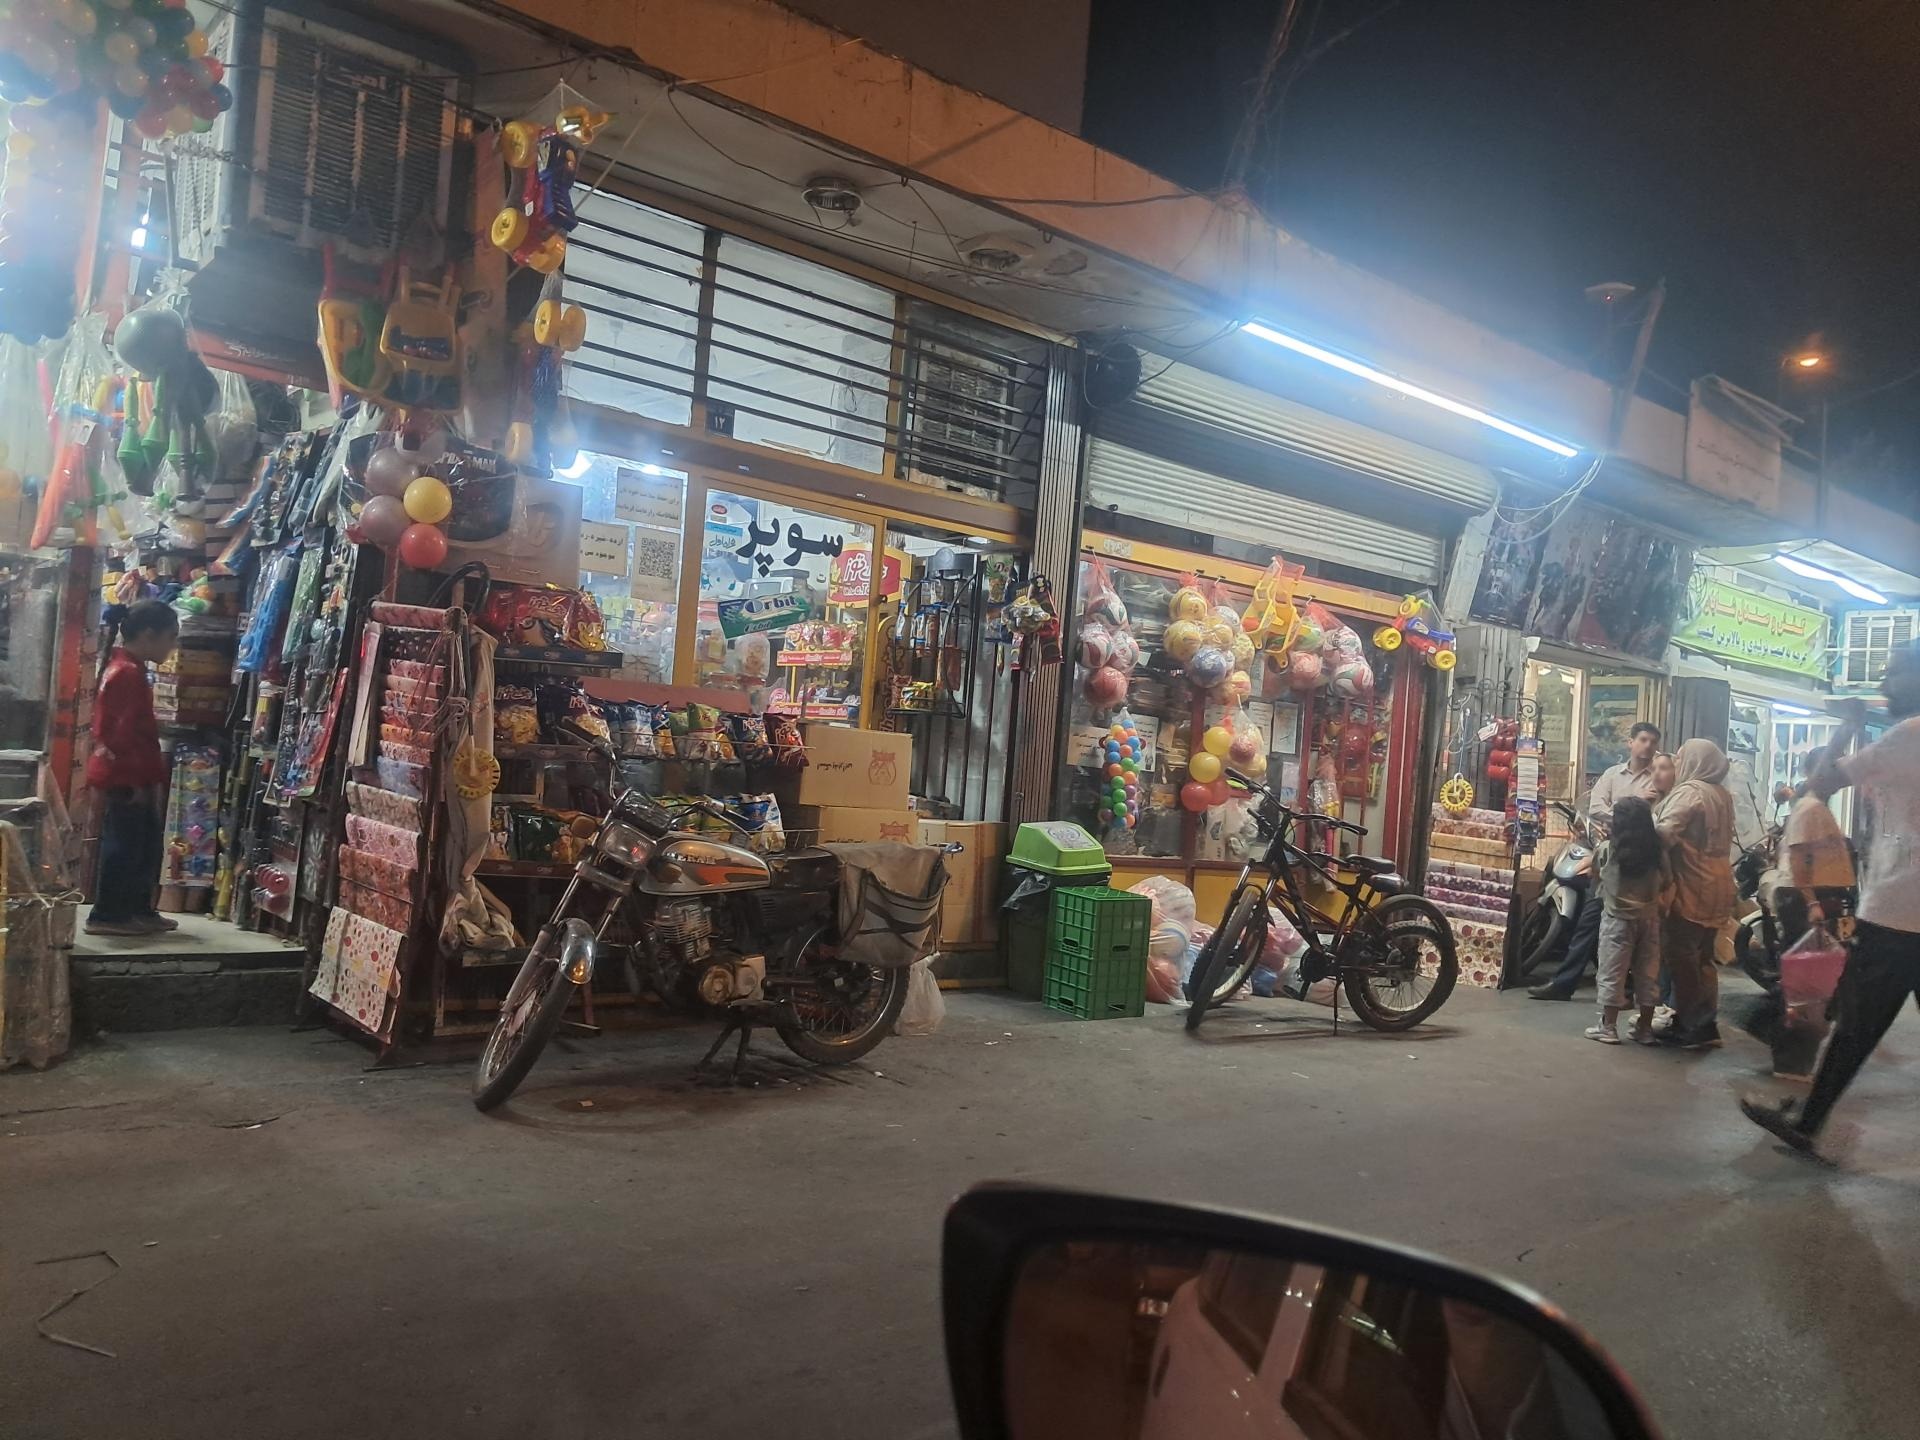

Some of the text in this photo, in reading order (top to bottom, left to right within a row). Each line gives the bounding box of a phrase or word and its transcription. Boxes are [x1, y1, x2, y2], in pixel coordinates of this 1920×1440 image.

[736, 517, 843, 575] سوپر
[744, 595, 797, 614] Orbit
[1716, 630, 1740, 647] بالاترین
